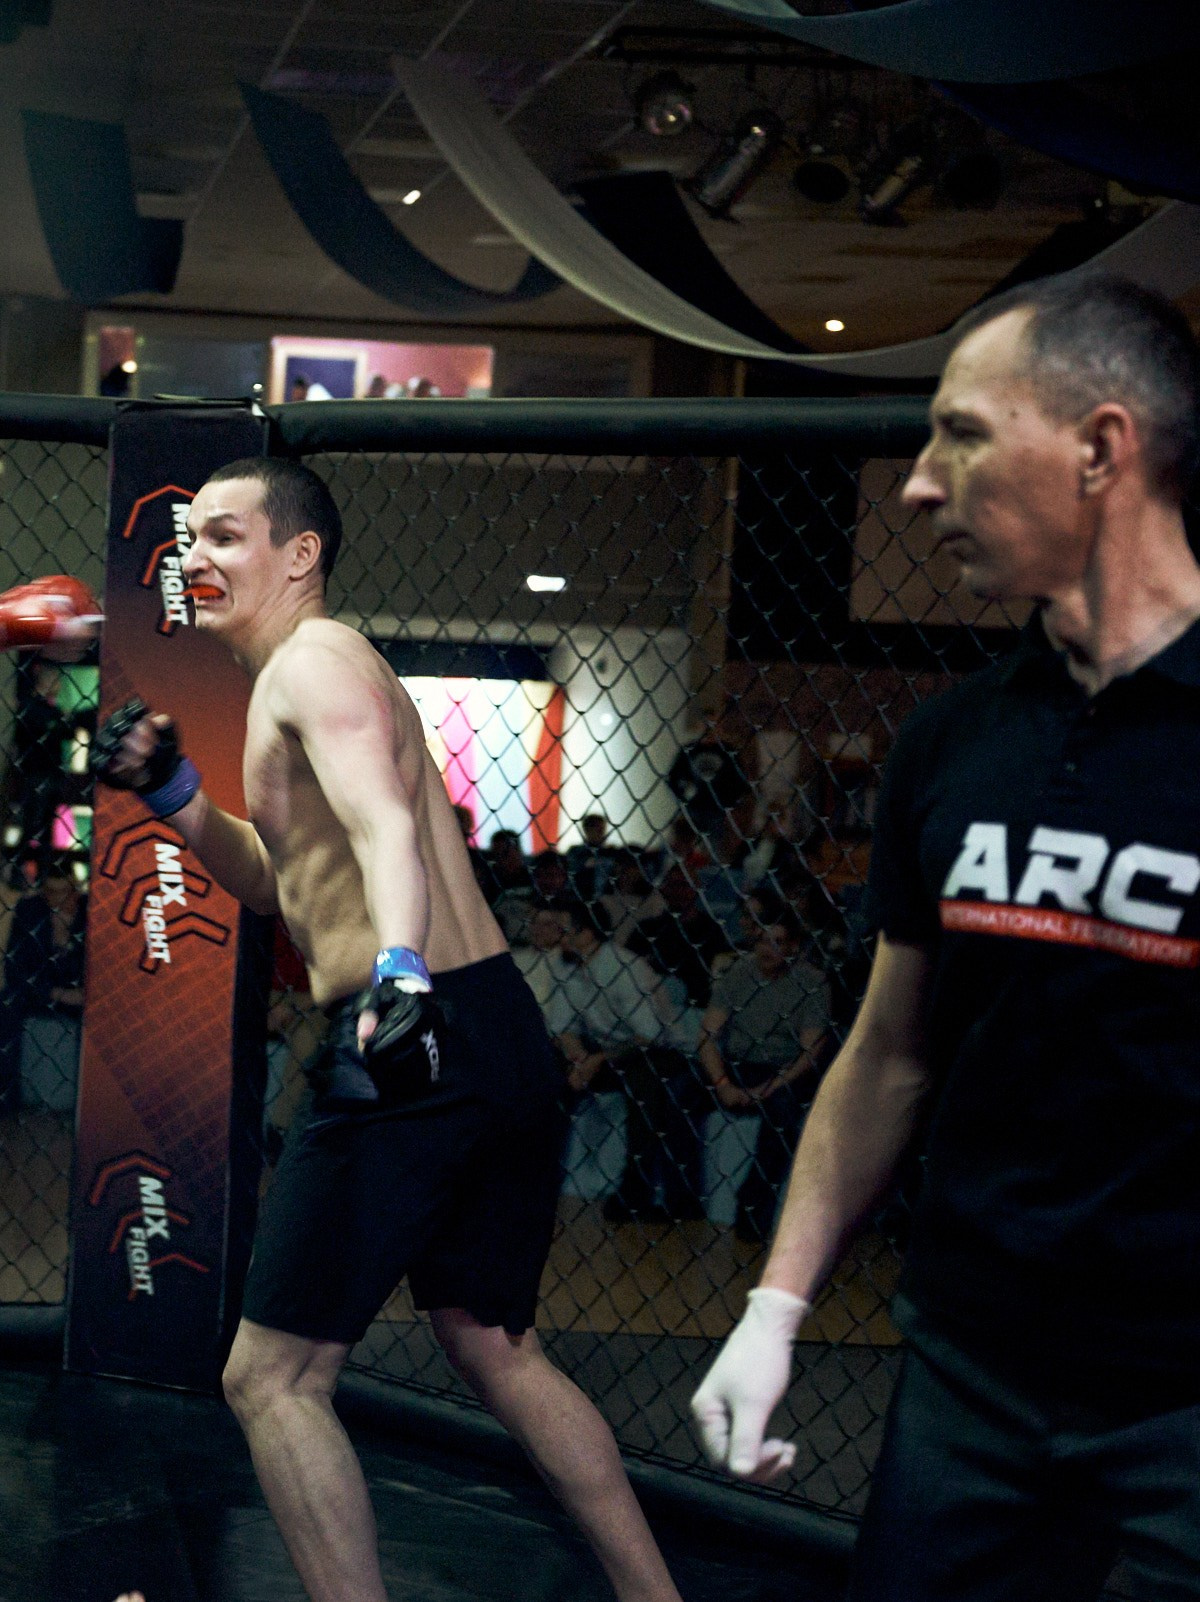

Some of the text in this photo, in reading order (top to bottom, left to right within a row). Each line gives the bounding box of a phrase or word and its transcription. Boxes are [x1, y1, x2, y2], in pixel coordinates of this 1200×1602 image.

[160, 556, 189, 625] FIGHT
[143, 843, 187, 964] MIX FIGHT
[940, 822, 1200, 935] ARC
[126, 1176, 171, 1296] MIX FIGHT
